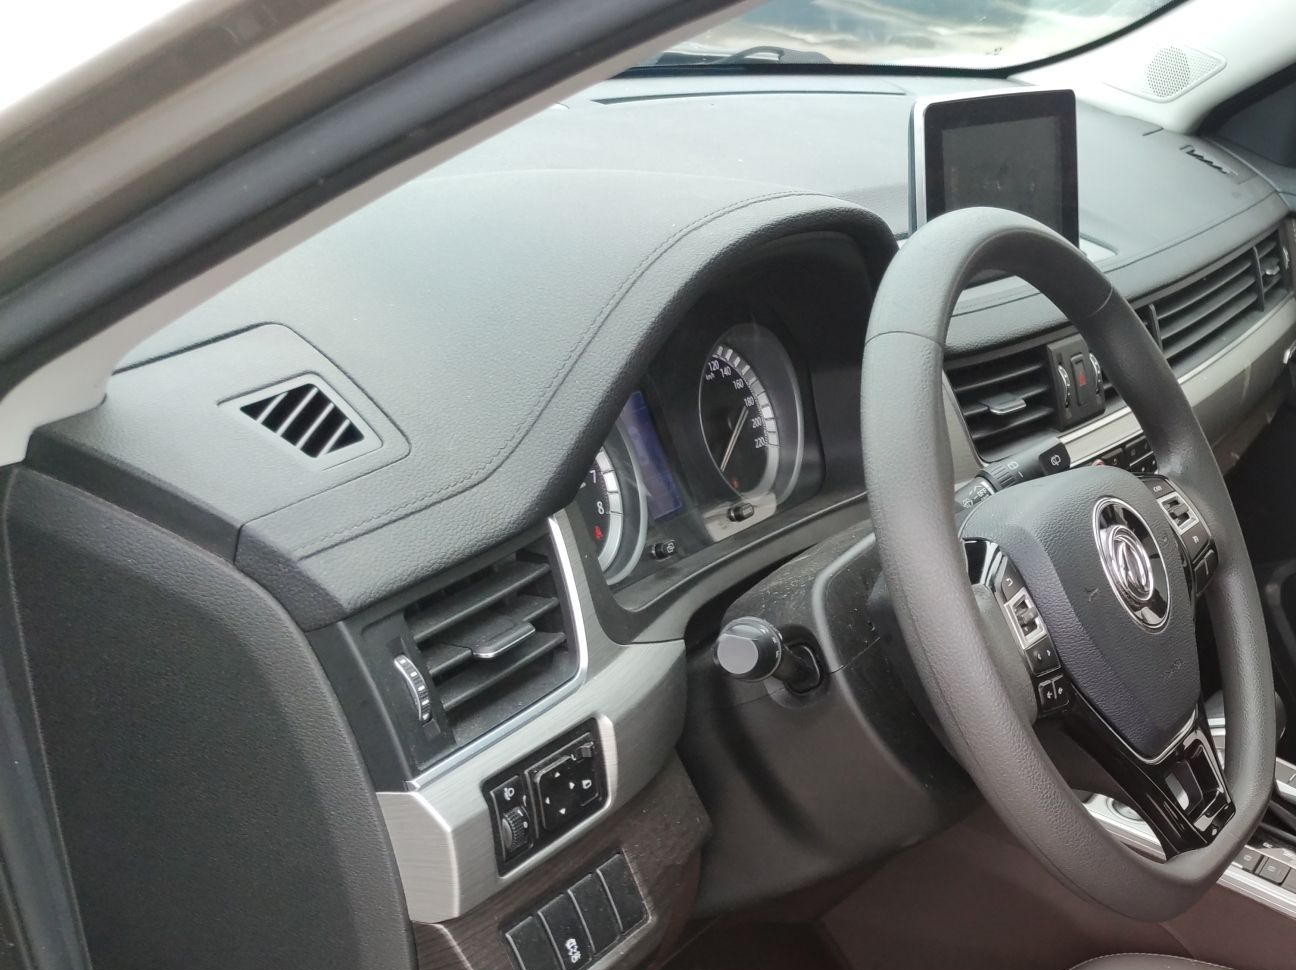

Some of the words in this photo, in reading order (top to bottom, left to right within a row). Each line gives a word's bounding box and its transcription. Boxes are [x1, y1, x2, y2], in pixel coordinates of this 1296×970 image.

[708, 360, 720, 371] 120
[720, 366, 732, 378] 140
[733, 378, 744, 389] 160
[744, 396, 755, 407] 180
[751, 416, 762, 428] 200
[755, 437, 765, 449] 220
[589, 469, 597, 484] 7
[596, 501, 605, 515] 8
